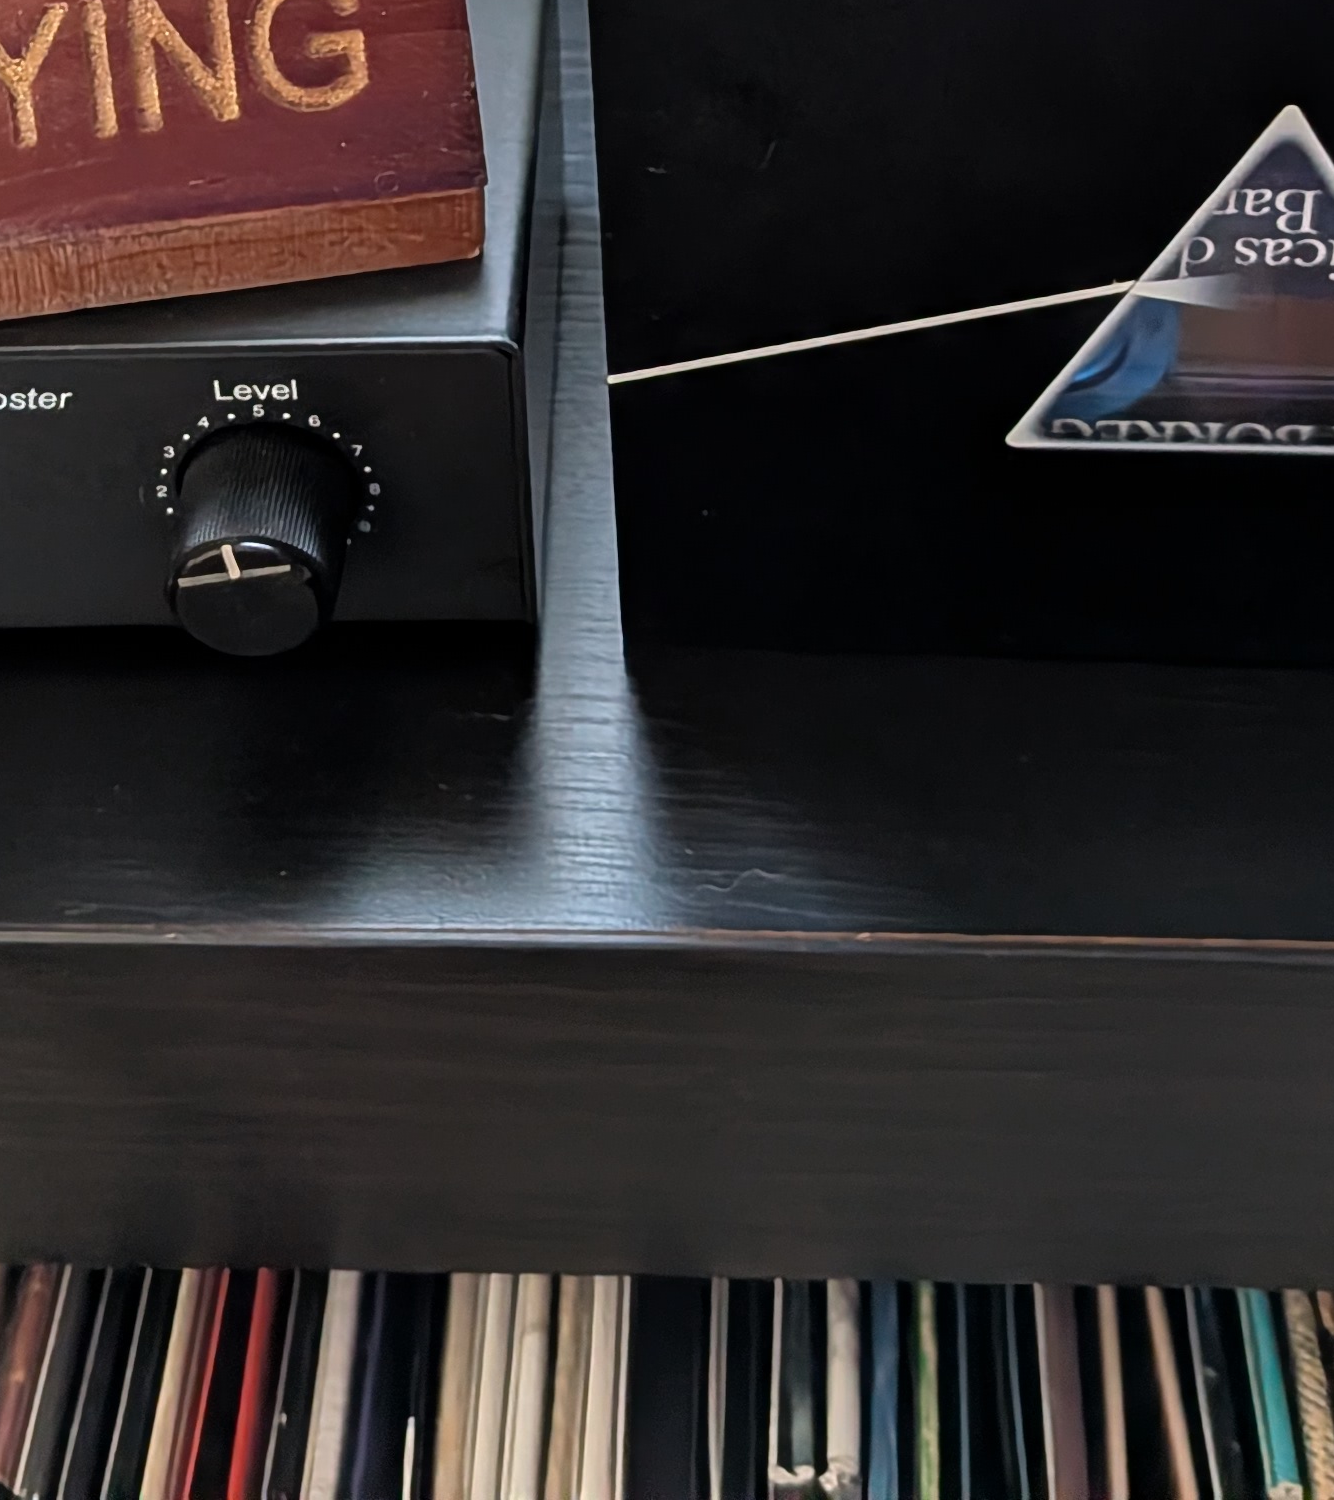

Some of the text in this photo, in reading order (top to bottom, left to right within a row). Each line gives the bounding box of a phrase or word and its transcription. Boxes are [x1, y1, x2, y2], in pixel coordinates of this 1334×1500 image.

[213, 379, 298, 401] Level
[197, 404, 321, 428] 4 5 6
[163, 444, 363, 458] 3 7
[156, 485, 168, 498] 2
